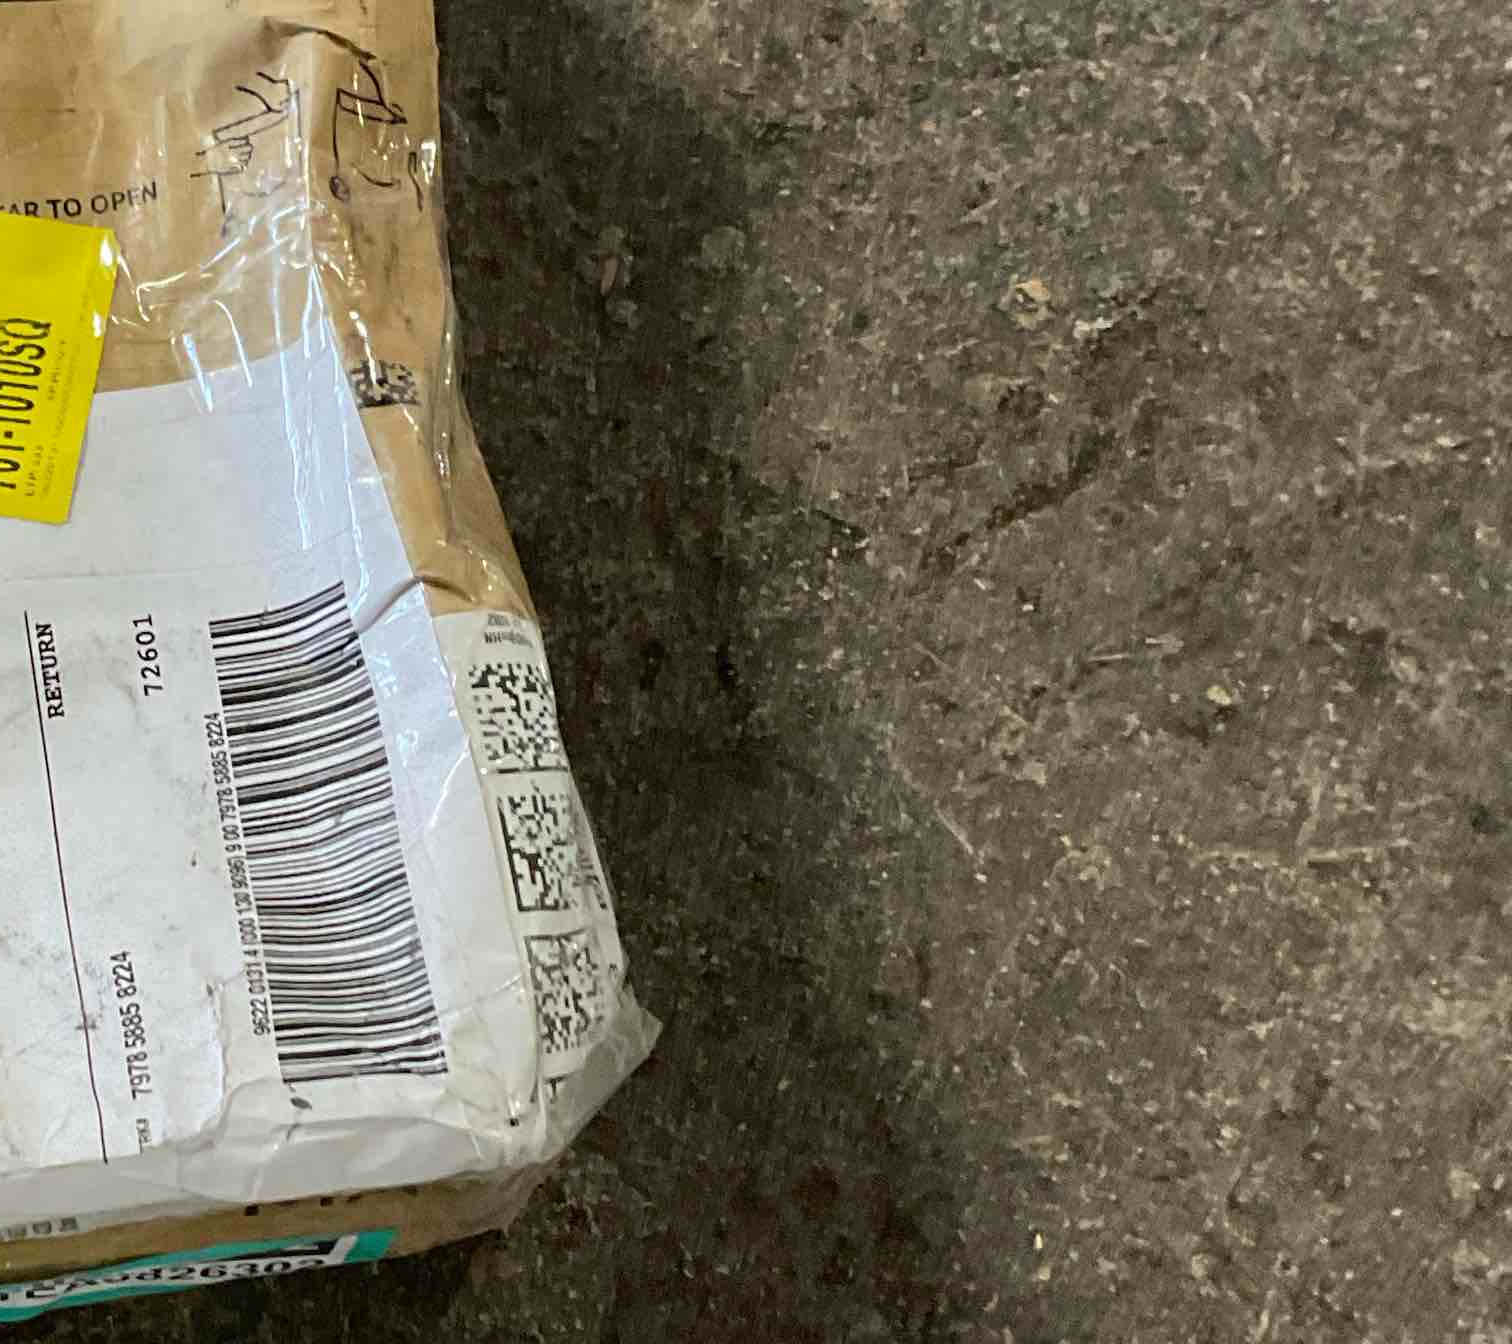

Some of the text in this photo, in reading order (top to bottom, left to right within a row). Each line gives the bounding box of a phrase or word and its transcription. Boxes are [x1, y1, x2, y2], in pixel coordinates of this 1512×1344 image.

[46, 197, 82, 219] TO
[90, 180, 158, 215] OPEN
[35, 623, 65, 719] RETURN
[132, 613, 164, 696] 72601
[203, 711, 225, 747] 8224
[209, 750, 232, 784] 5885
[215, 787, 236, 822] 7978
[221, 823, 239, 840] 00
[224, 844, 242, 853] 9
[243, 949, 260, 957] 4
[109, 950, 138, 997] 8224
[243, 961, 266, 994] 0131
[118, 1002, 147, 1048] 5885
[248, 997, 271, 1035] 9622
[125, 1051, 152, 1100] 7978
